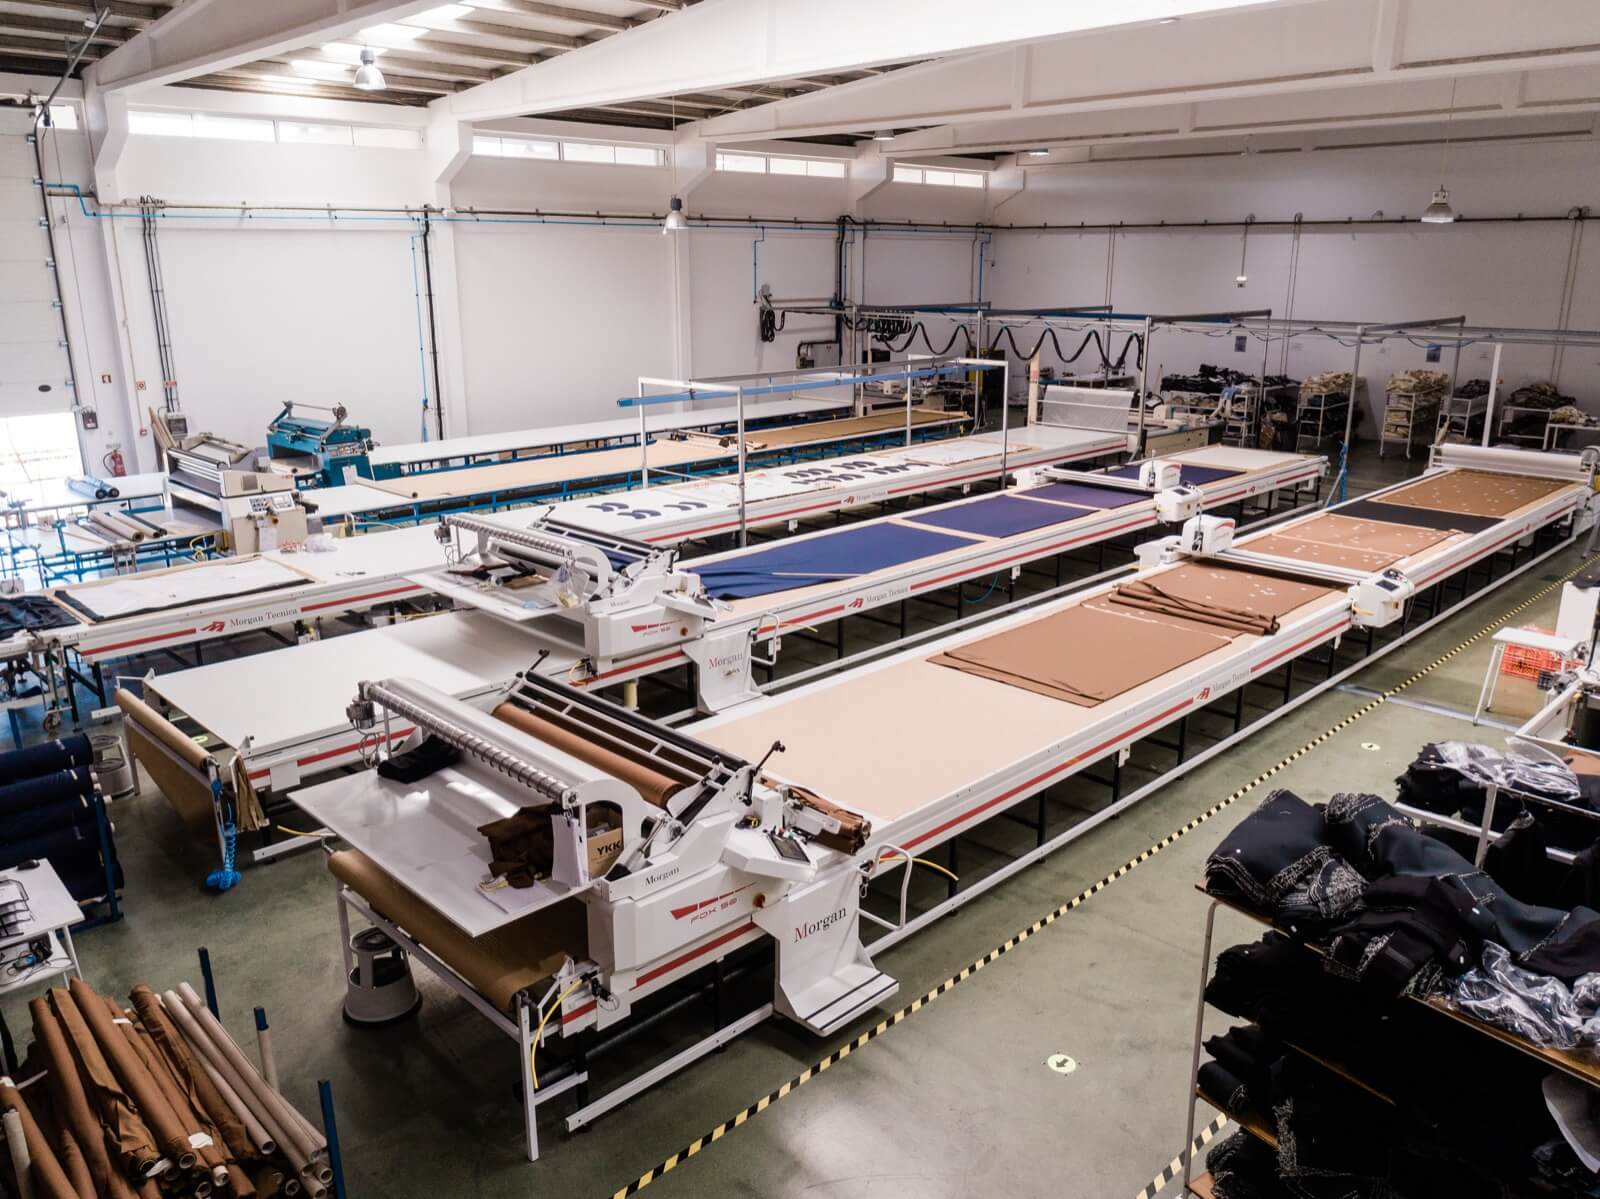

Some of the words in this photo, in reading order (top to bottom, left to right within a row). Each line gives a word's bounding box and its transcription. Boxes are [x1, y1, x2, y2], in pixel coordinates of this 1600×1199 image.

[229, 615, 264, 627] Morgan
[265, 608, 298, 620] Tecnica
[597, 841, 621, 855] YKK
[644, 867, 680, 886] Morgan
[794, 907, 847, 943] Morgan
